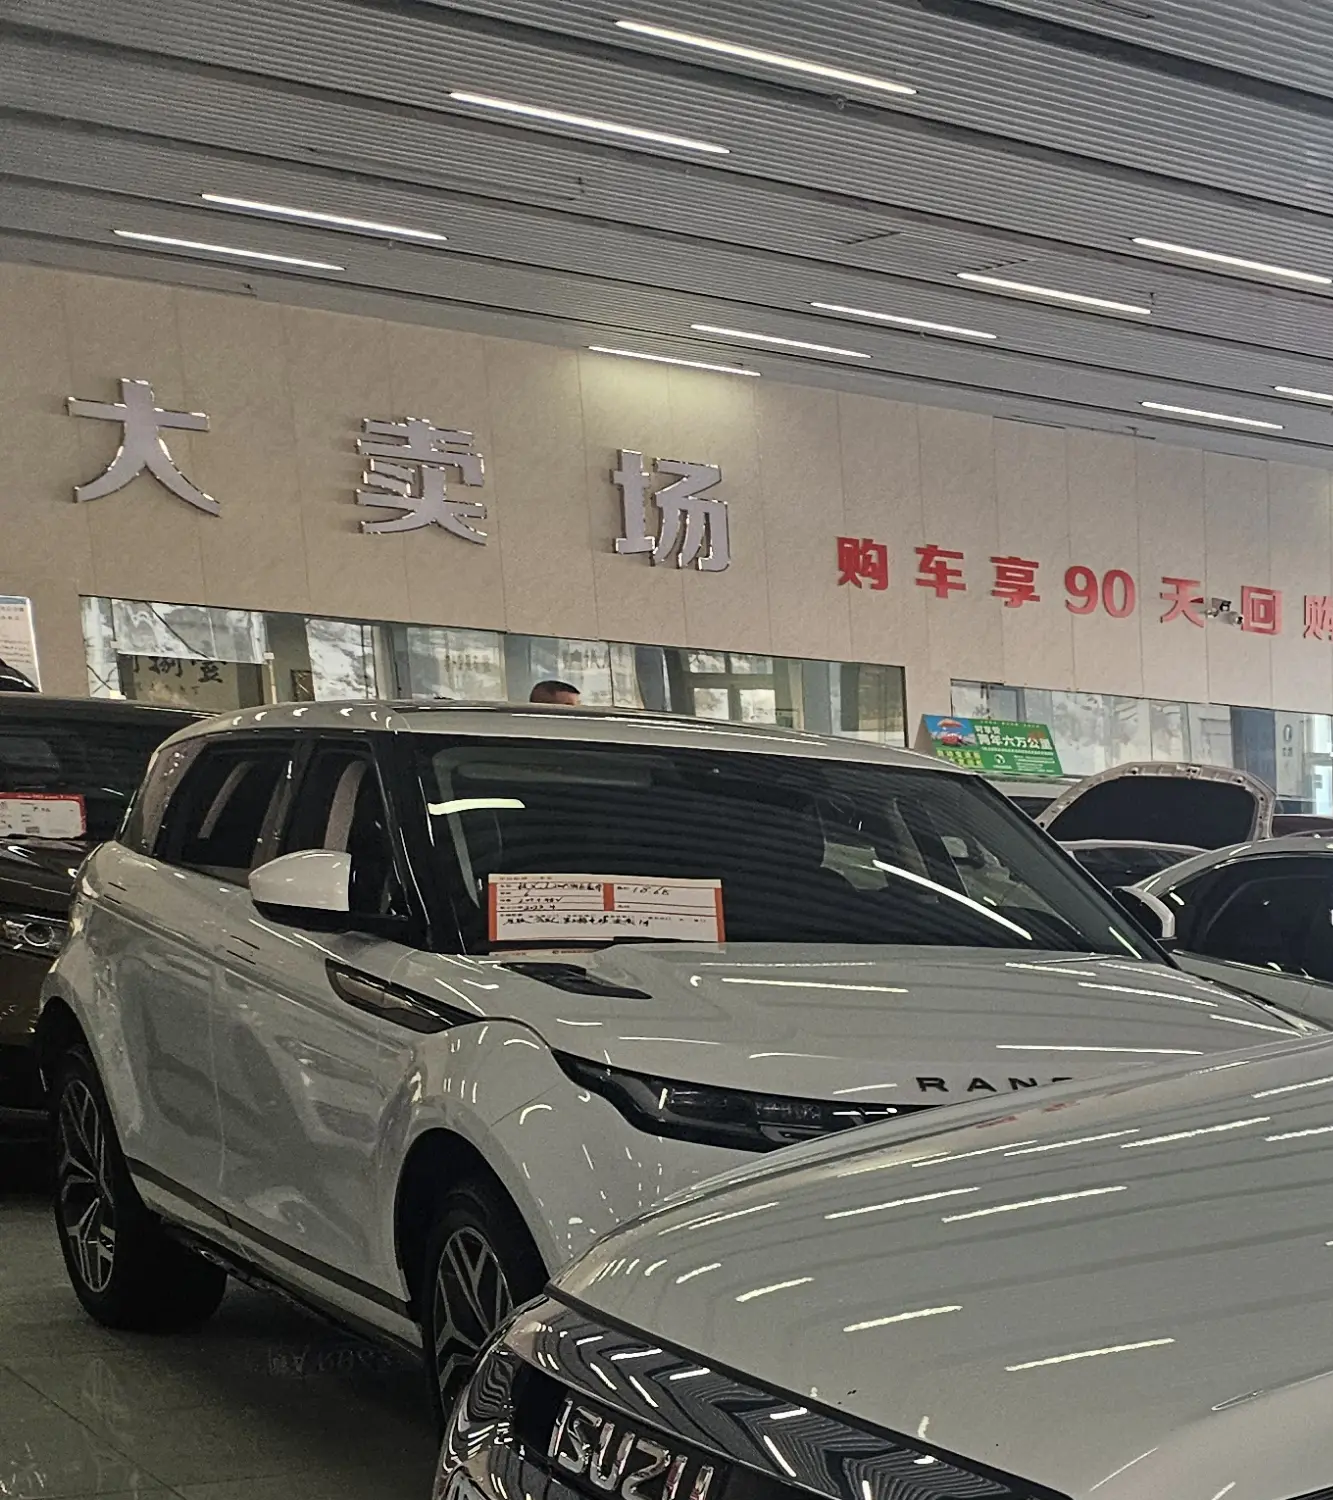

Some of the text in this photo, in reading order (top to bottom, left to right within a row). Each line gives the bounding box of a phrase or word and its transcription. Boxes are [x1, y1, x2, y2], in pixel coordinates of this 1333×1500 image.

[66, 377, 732, 573] 大卖场
[915, 1077, 1072, 1093] RAN
